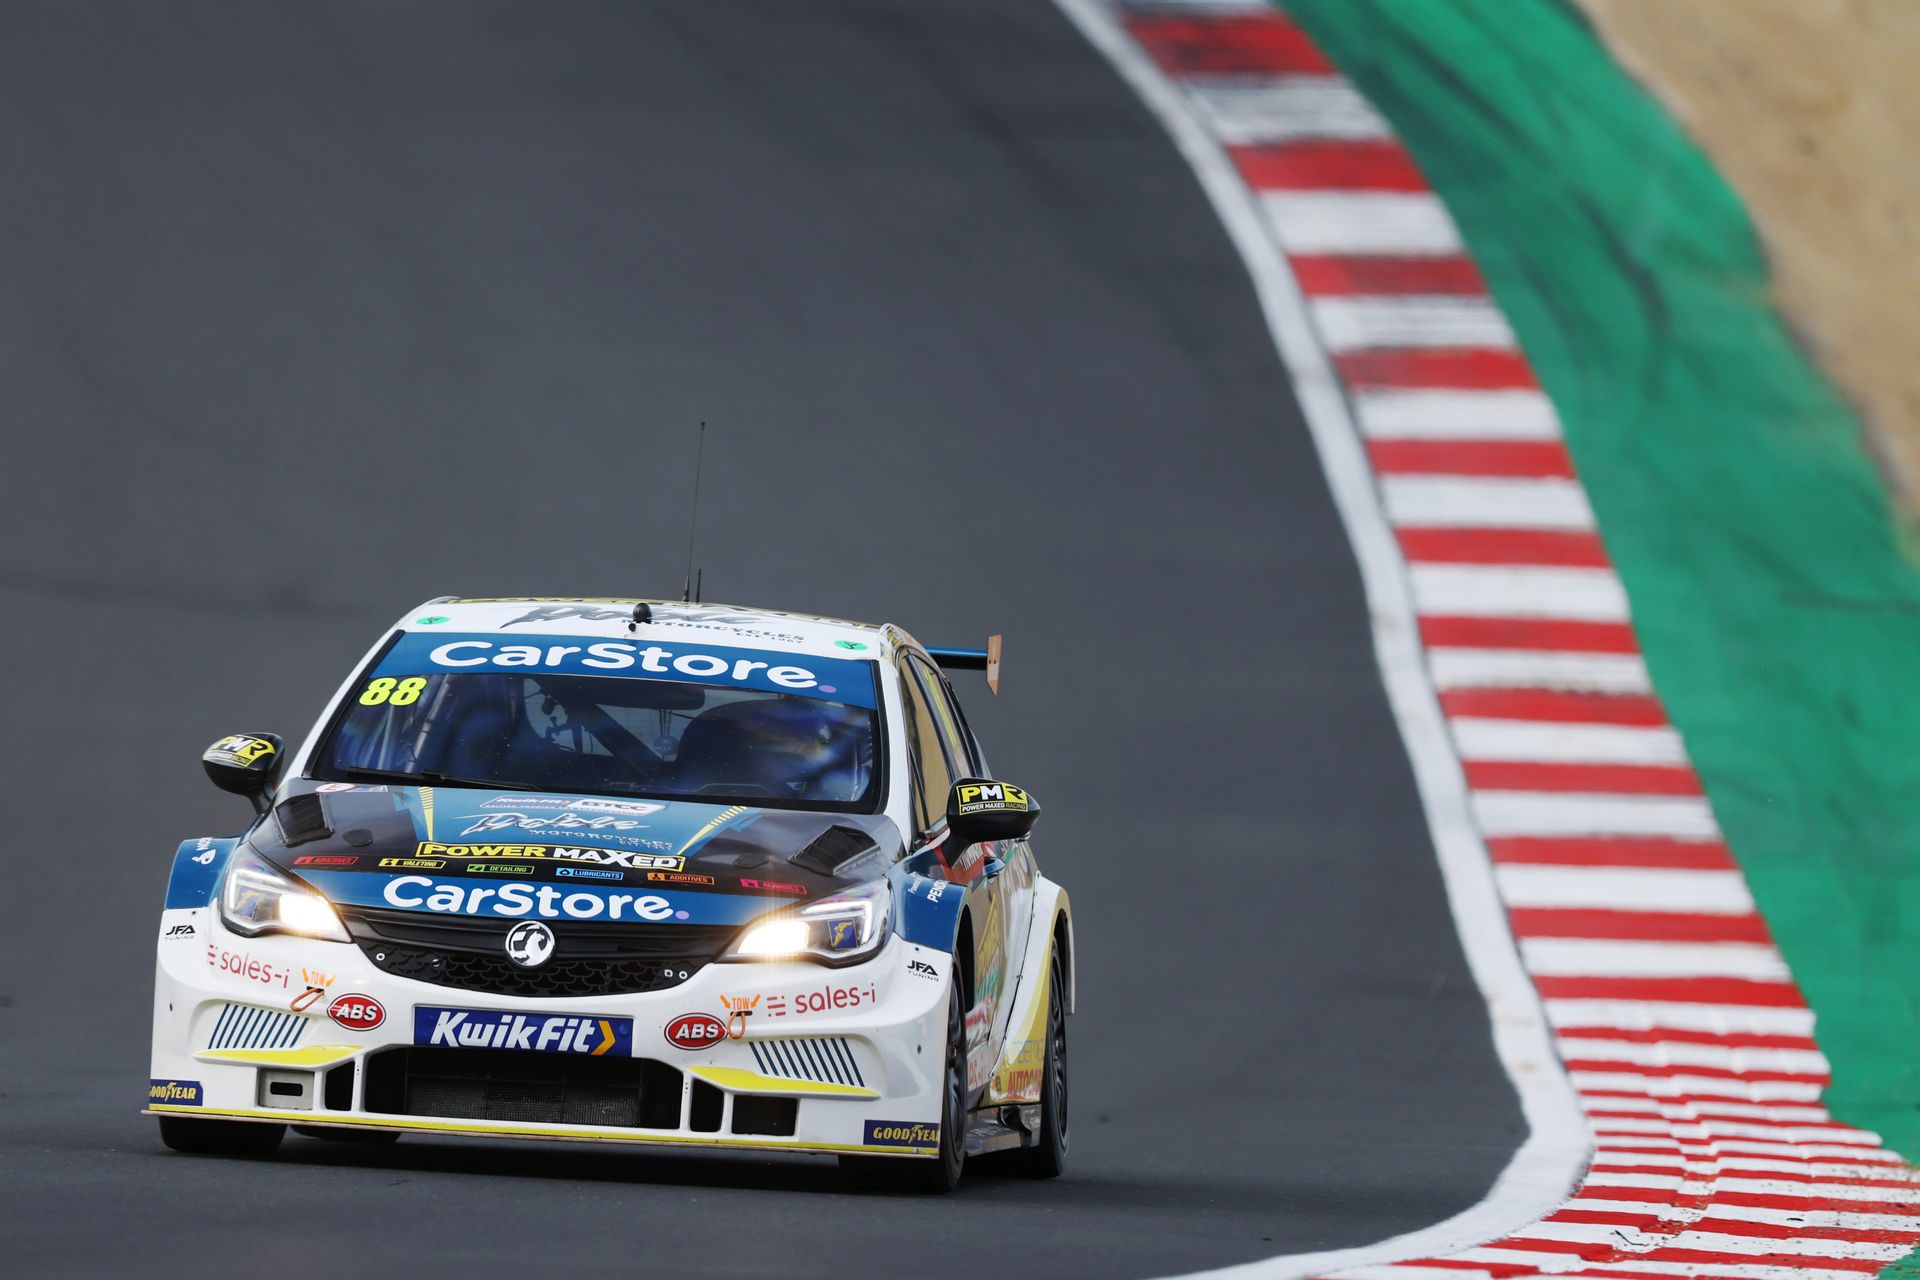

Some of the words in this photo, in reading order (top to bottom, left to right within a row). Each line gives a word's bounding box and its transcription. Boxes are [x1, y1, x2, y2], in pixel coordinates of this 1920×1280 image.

[359, 677, 428, 706] 88
[212, 736, 269, 757] PMR
[961, 785, 1024, 803] PMR
[962, 804, 984, 813] POWER
[402, 860, 437, 868] VALETING
[423, 844, 547, 858] POWER
[553, 847, 679, 869] MAXED
[489, 865, 527, 873] DETAILING
[574, 870, 621, 880] LUBRICANTS
[669, 874, 708, 884] ADDITIVES
[166, 925, 196, 935] JFA
[219, 950, 290, 989] sales-i
[907, 960, 939, 976] JFA
[908, 970, 939, 981] TUNING
[311, 971, 327, 986] TOW
[731, 996, 750, 1010] TOW
[795, 983, 876, 1013] sales-i
[336, 1005, 377, 1021] ABS
[674, 1023, 719, 1039] ABS
